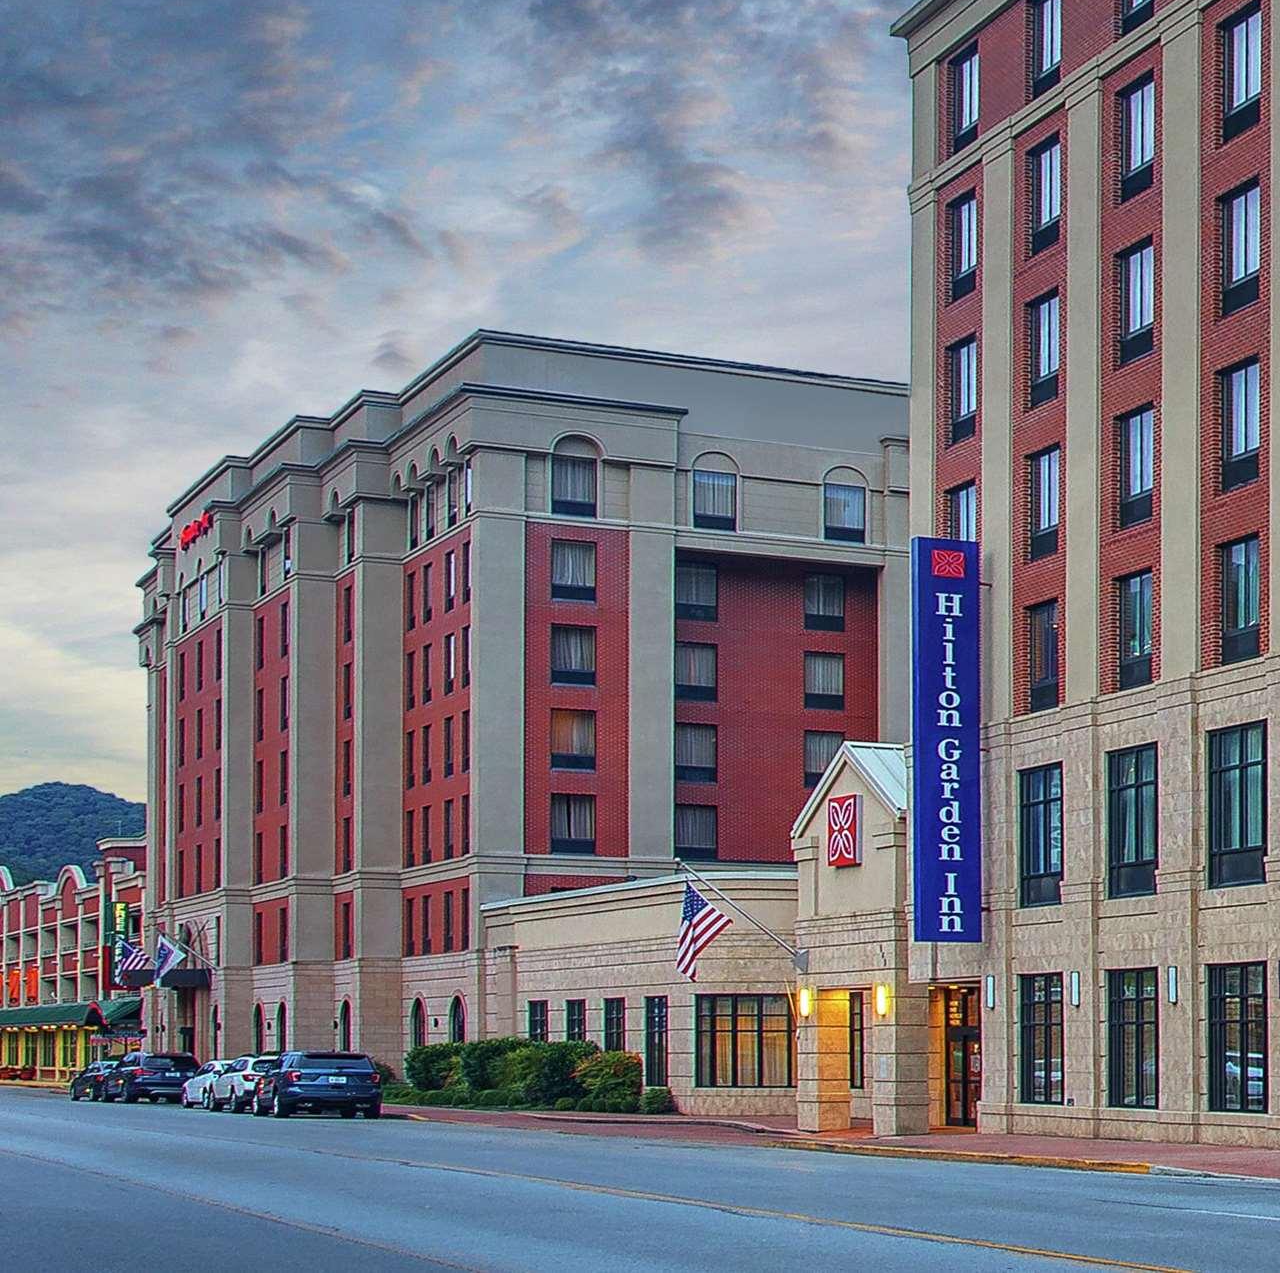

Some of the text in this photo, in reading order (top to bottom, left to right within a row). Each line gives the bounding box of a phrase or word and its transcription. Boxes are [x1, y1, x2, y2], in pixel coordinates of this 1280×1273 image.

[935, 592, 964, 932] Hilton Garden Inn
